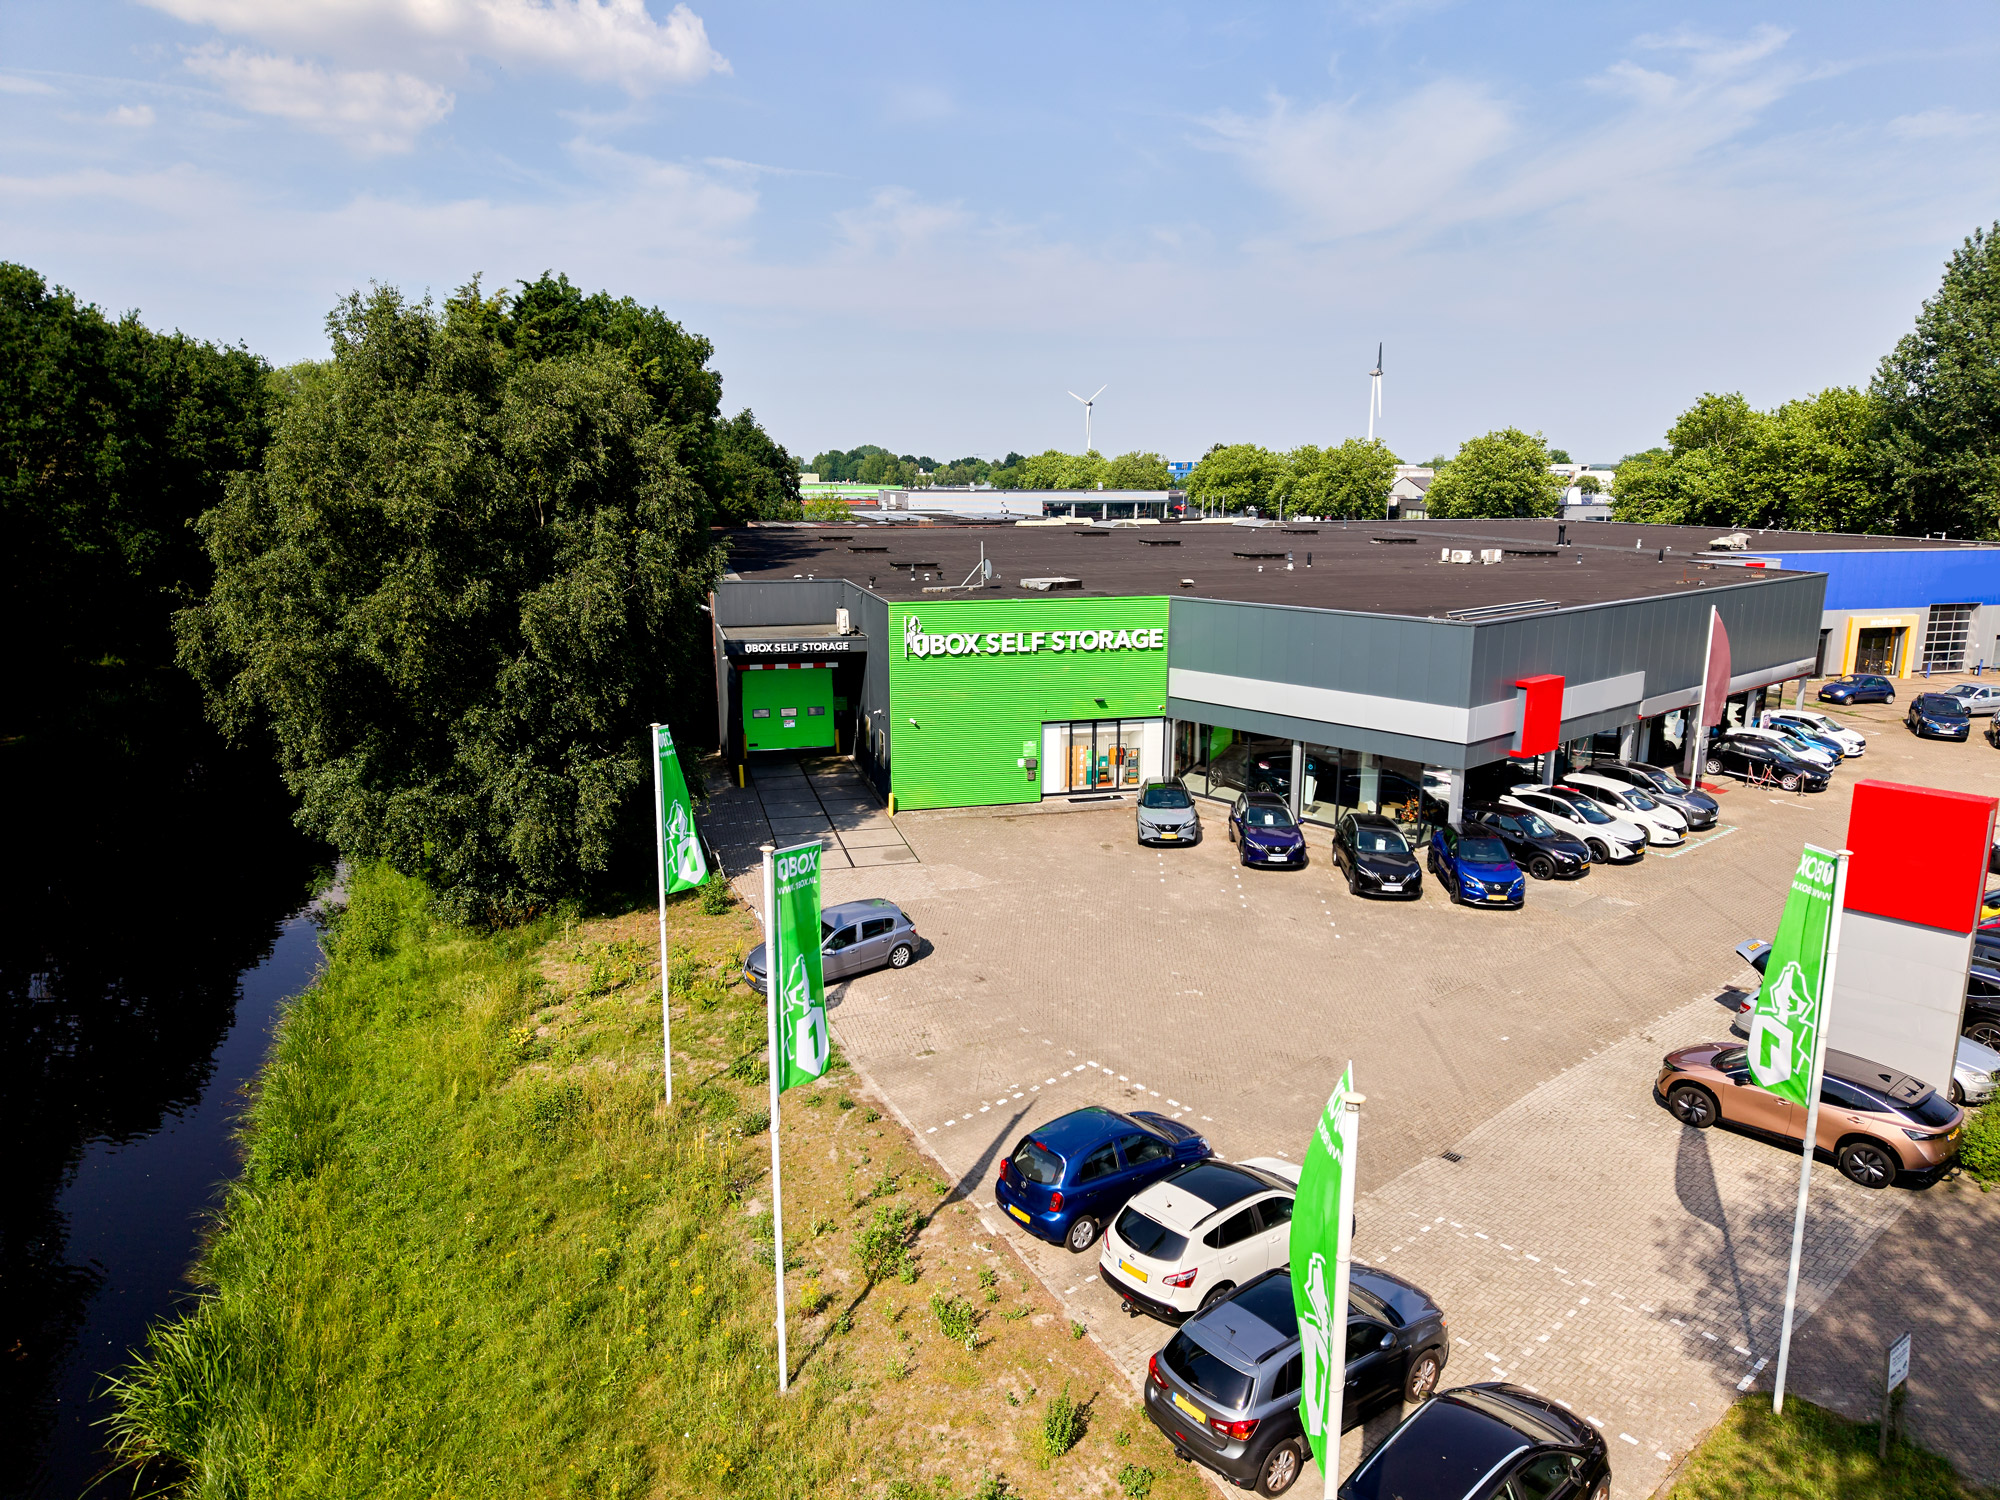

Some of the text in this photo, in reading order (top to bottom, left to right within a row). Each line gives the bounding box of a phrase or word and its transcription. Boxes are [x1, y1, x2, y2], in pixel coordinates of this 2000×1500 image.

[774, 642, 799, 652] SELF
[802, 641, 849, 651] STORAGE
[985, 631, 1045, 653] SELF
[1051, 628, 1164, 651] STORAGE
